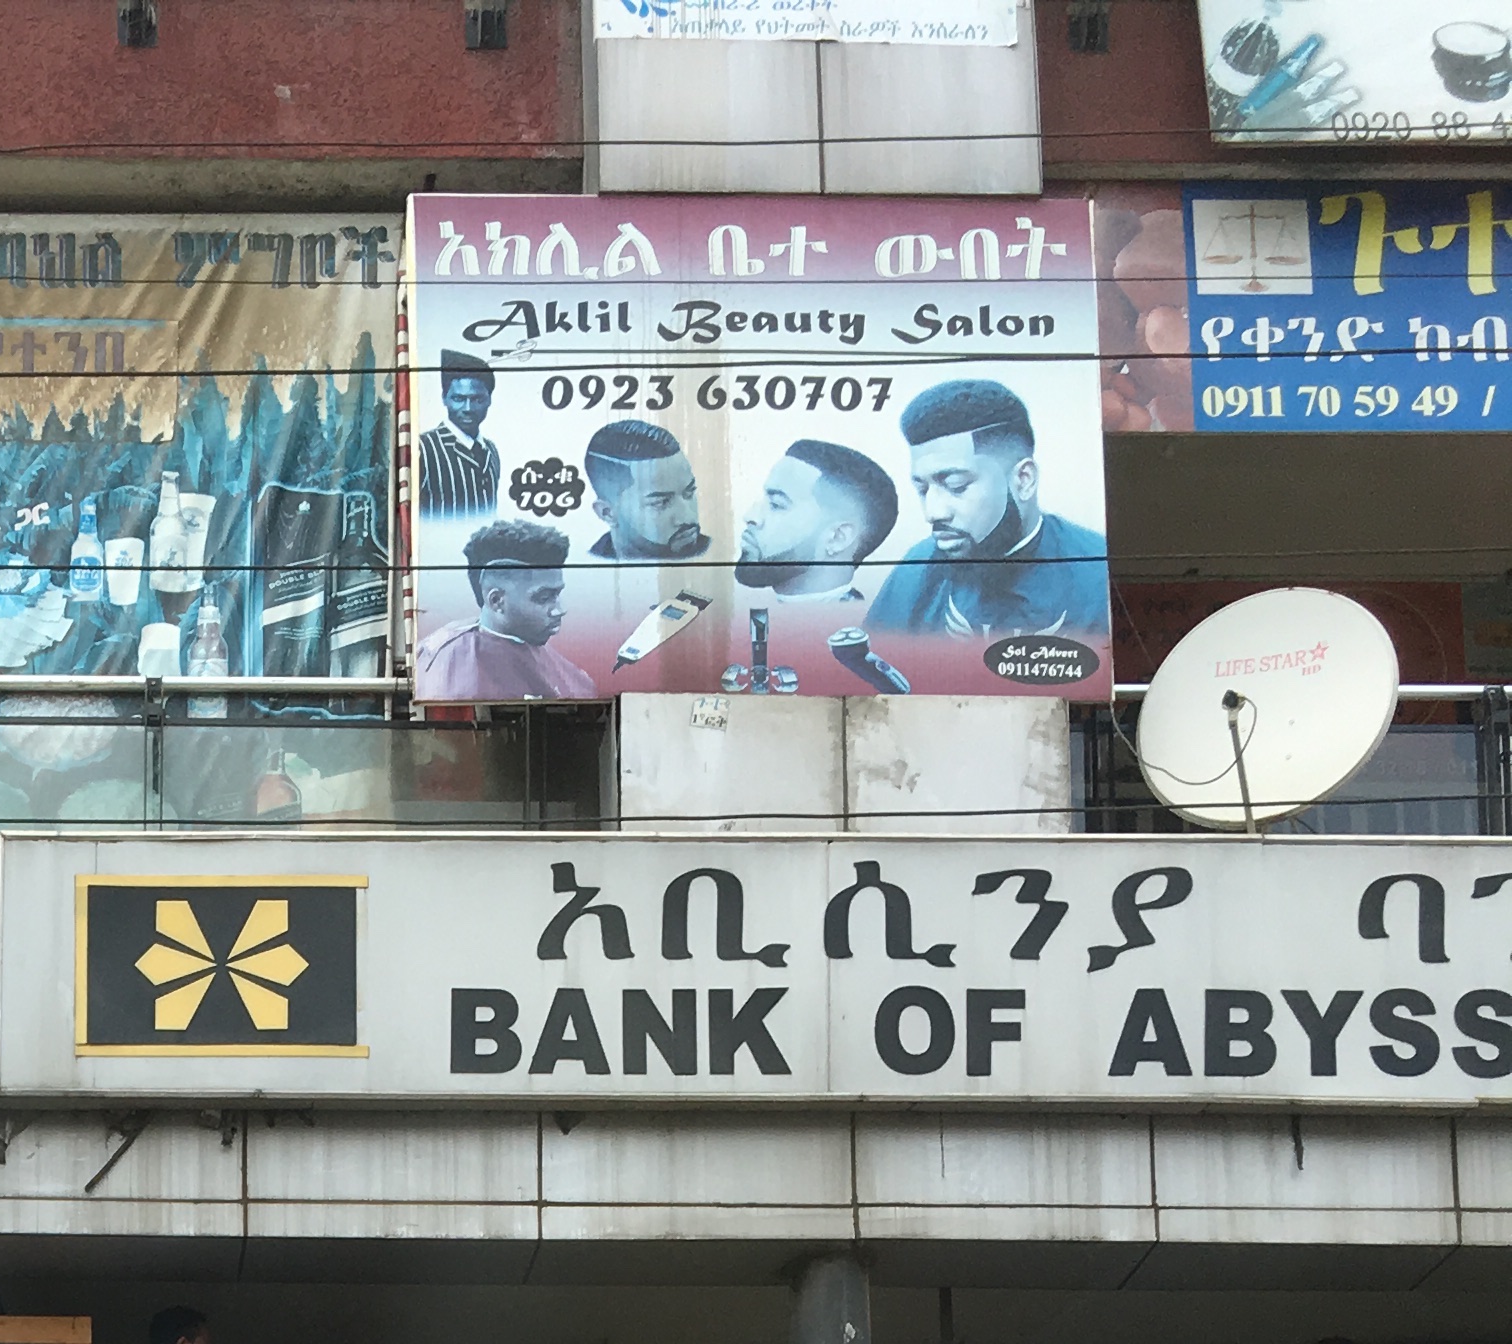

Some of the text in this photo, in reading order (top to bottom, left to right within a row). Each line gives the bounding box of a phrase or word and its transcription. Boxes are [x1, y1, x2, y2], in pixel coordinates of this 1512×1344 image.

[1332, 111, 1412, 141] 0920
[434, 216, 1068, 280] አክሊል ቤተ ውበት
[462, 300, 1055, 345] Aklil Beauty Salon
[542, 375, 893, 411] 0923 630707
[1201, 385, 1285, 417] 0911
[1297, 385, 1341, 417] 70
[1353, 385, 1399, 417] 59
[1411, 385, 1459, 417] 49
[520, 491, 575, 507] 106
[1001, 644, 1027, 659] Sol
[1214, 649, 1307, 678] LIFE STAR
[997, 662, 1083, 678] 0911476744
[1301, 663, 1322, 677] HD
[537, 861, 1193, 972] አቢሲንያ
[449, 987, 791, 1075] BANK
[873, 985, 1026, 1075] OF
